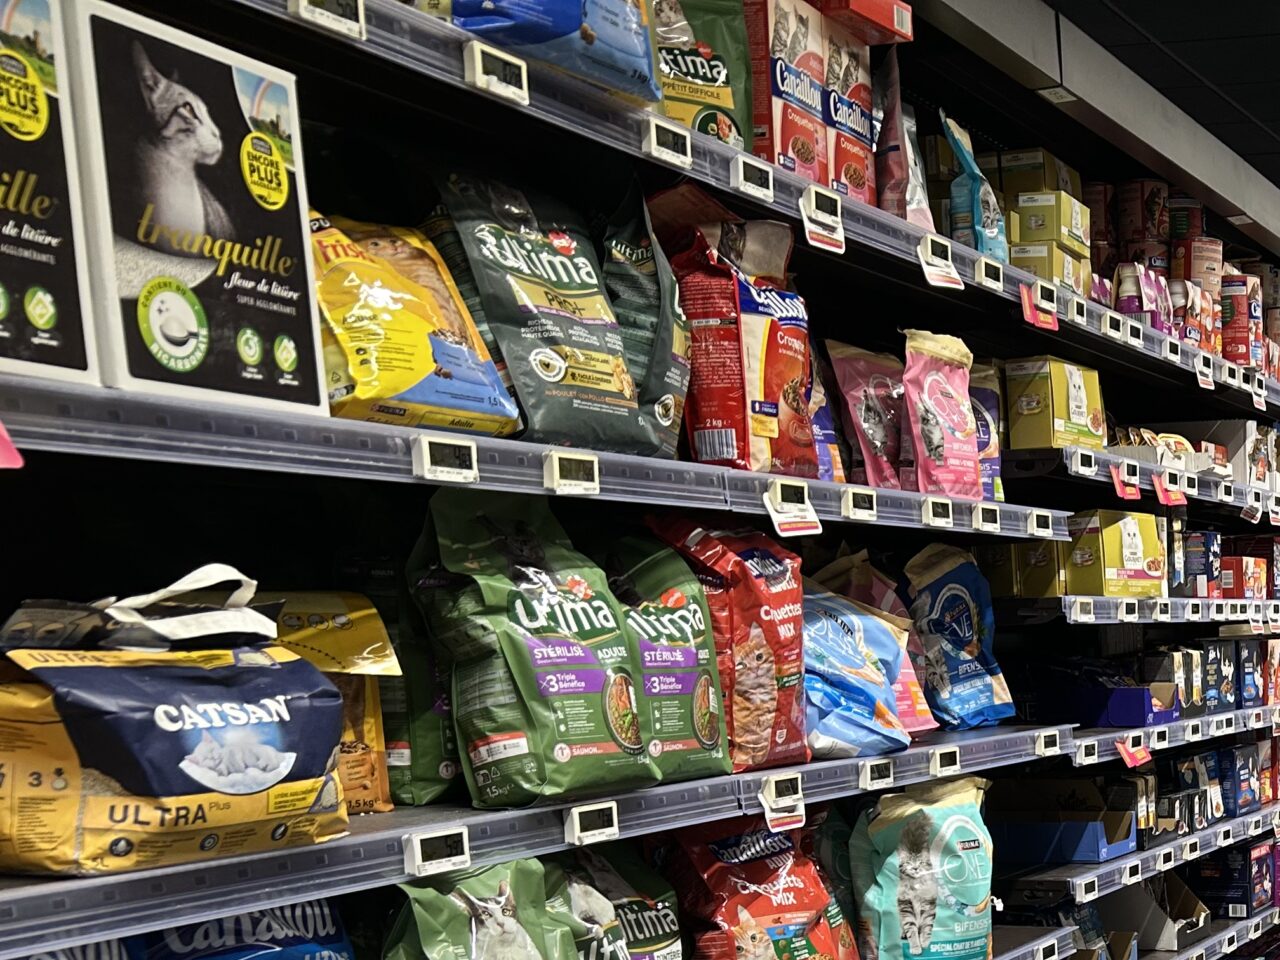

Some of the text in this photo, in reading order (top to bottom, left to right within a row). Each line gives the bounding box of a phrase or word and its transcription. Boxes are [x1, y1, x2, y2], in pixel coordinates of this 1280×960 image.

[0, 74, 38, 95] NCORE
[661, 80, 688, 94] PPÉTIT
[775, 57, 823, 112] Canaillou
[829, 91, 874, 139] Canaillou
[247, 151, 281, 172] ENCORE
[249, 163, 282, 187] PLUS
[136, 204, 295, 277] tranquille
[257, 279, 269, 293] de
[712, 418, 723, 429] kg
[777, 622, 796, 640] MIX
[556, 673, 577, 684] Triple
[558, 680, 586, 690] Bénéfice
[659, 676, 677, 685] Triple
[153, 695, 293, 733] CATSAN
[28, 771, 43, 787] 3
[107, 800, 232, 830] ULTRA Plus
[943, 852, 989, 883] ONE
[771, 891, 798, 908] MIX
[954, 919, 990, 933] BIFENSIS
